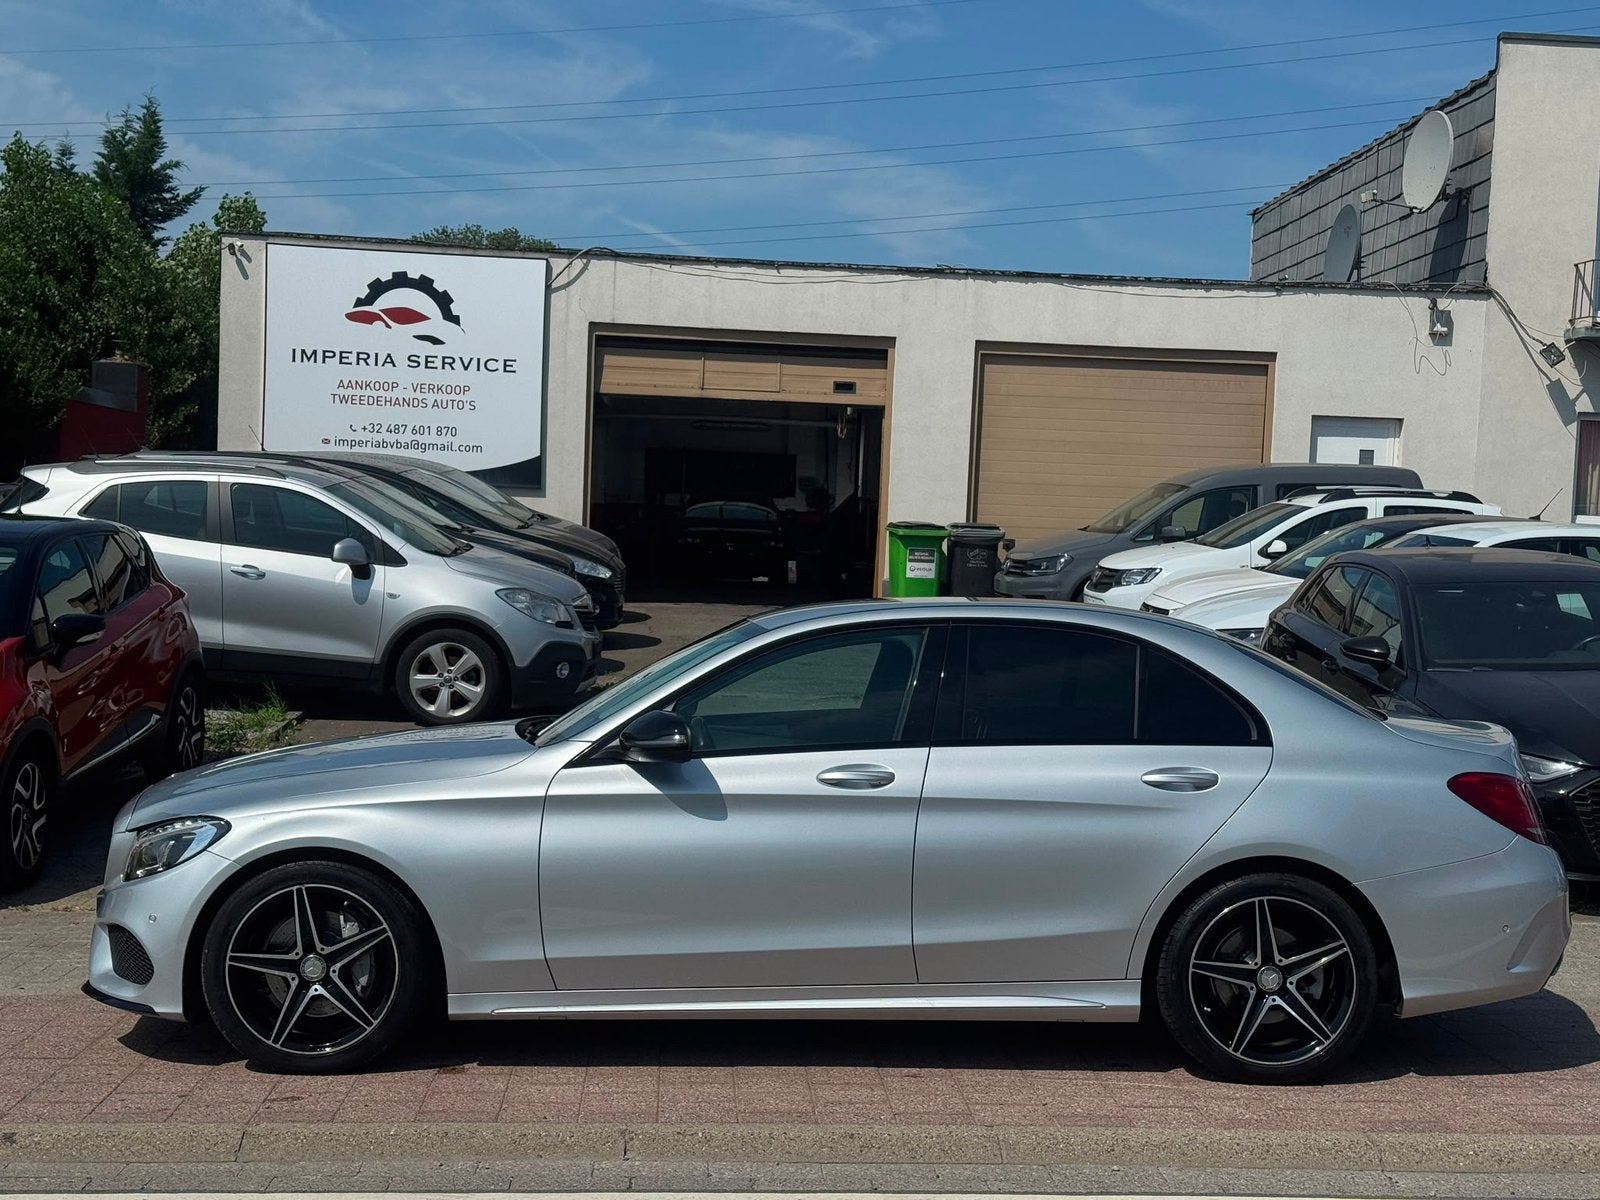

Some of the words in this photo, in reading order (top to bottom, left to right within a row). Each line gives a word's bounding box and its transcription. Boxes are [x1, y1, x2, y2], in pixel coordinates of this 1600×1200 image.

[291, 348, 397, 368] IMPERIA
[407, 354, 517, 374] SERVICE
[337, 379, 399, 393] AANKOOP
[411, 382, 471, 396] VERKOOP
[330, 393, 428, 409] TWEEDEHANDS
[431, 399, 476, 411] AUTO'S
[360, 423, 383, 435] +32
[385, 424, 408, 436] 487
[411, 425, 432, 437] 601
[436, 426, 458, 438] 870
[333, 436, 483, 454] imperiabvba@gmail.com
